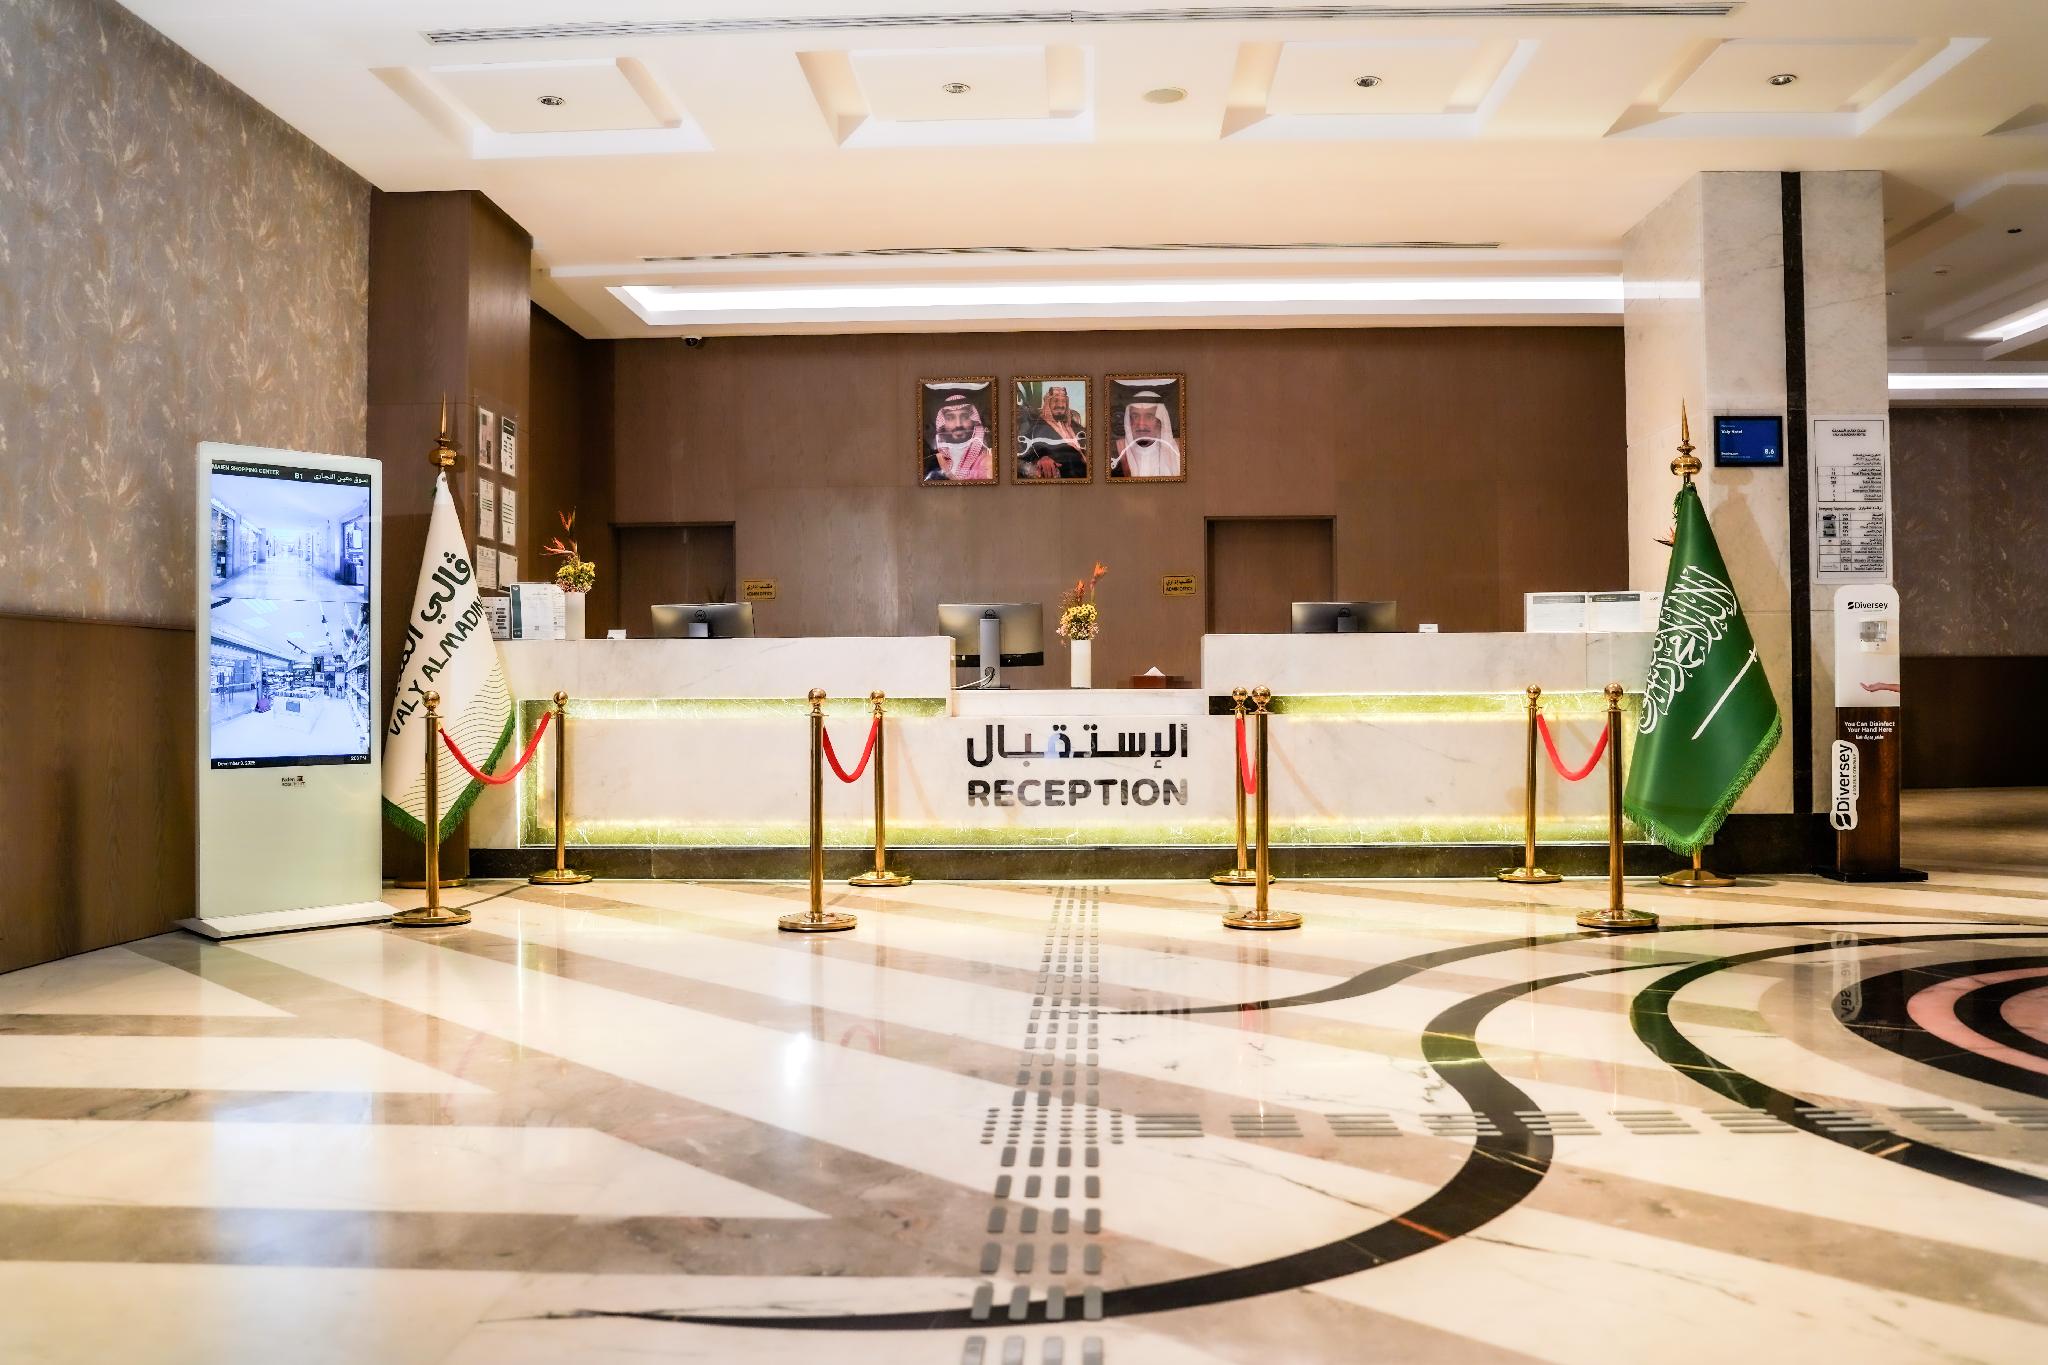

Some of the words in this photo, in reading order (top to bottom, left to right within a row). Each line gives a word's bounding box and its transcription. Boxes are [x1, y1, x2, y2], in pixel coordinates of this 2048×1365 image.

[294, 472, 303, 480] B1
[1854, 601, 1889, 610] Diversey
[421, 596, 484, 683] ALMADIN
[1836, 743, 1852, 812] Diversey
[967, 778, 1188, 807] RECEPTION
